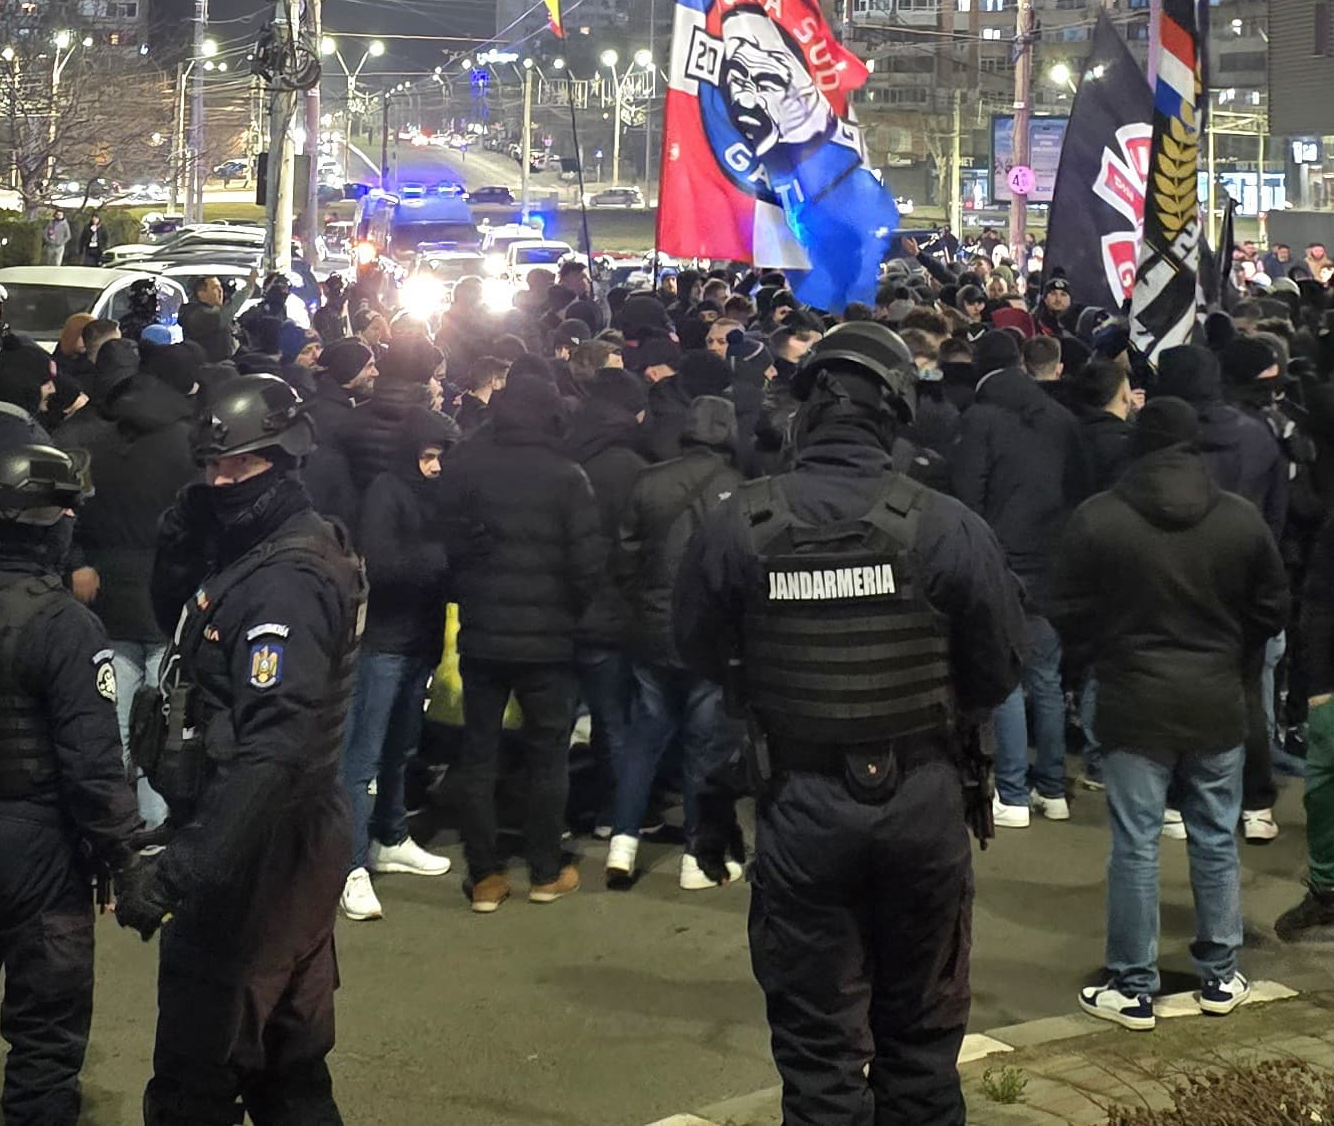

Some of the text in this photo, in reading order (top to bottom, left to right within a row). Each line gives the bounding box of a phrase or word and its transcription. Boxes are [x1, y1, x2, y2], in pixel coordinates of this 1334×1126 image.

[695, 40, 718, 75] 20
[793, 17, 840, 91] SUD
[768, 564, 896, 600] JANDARMERIA
